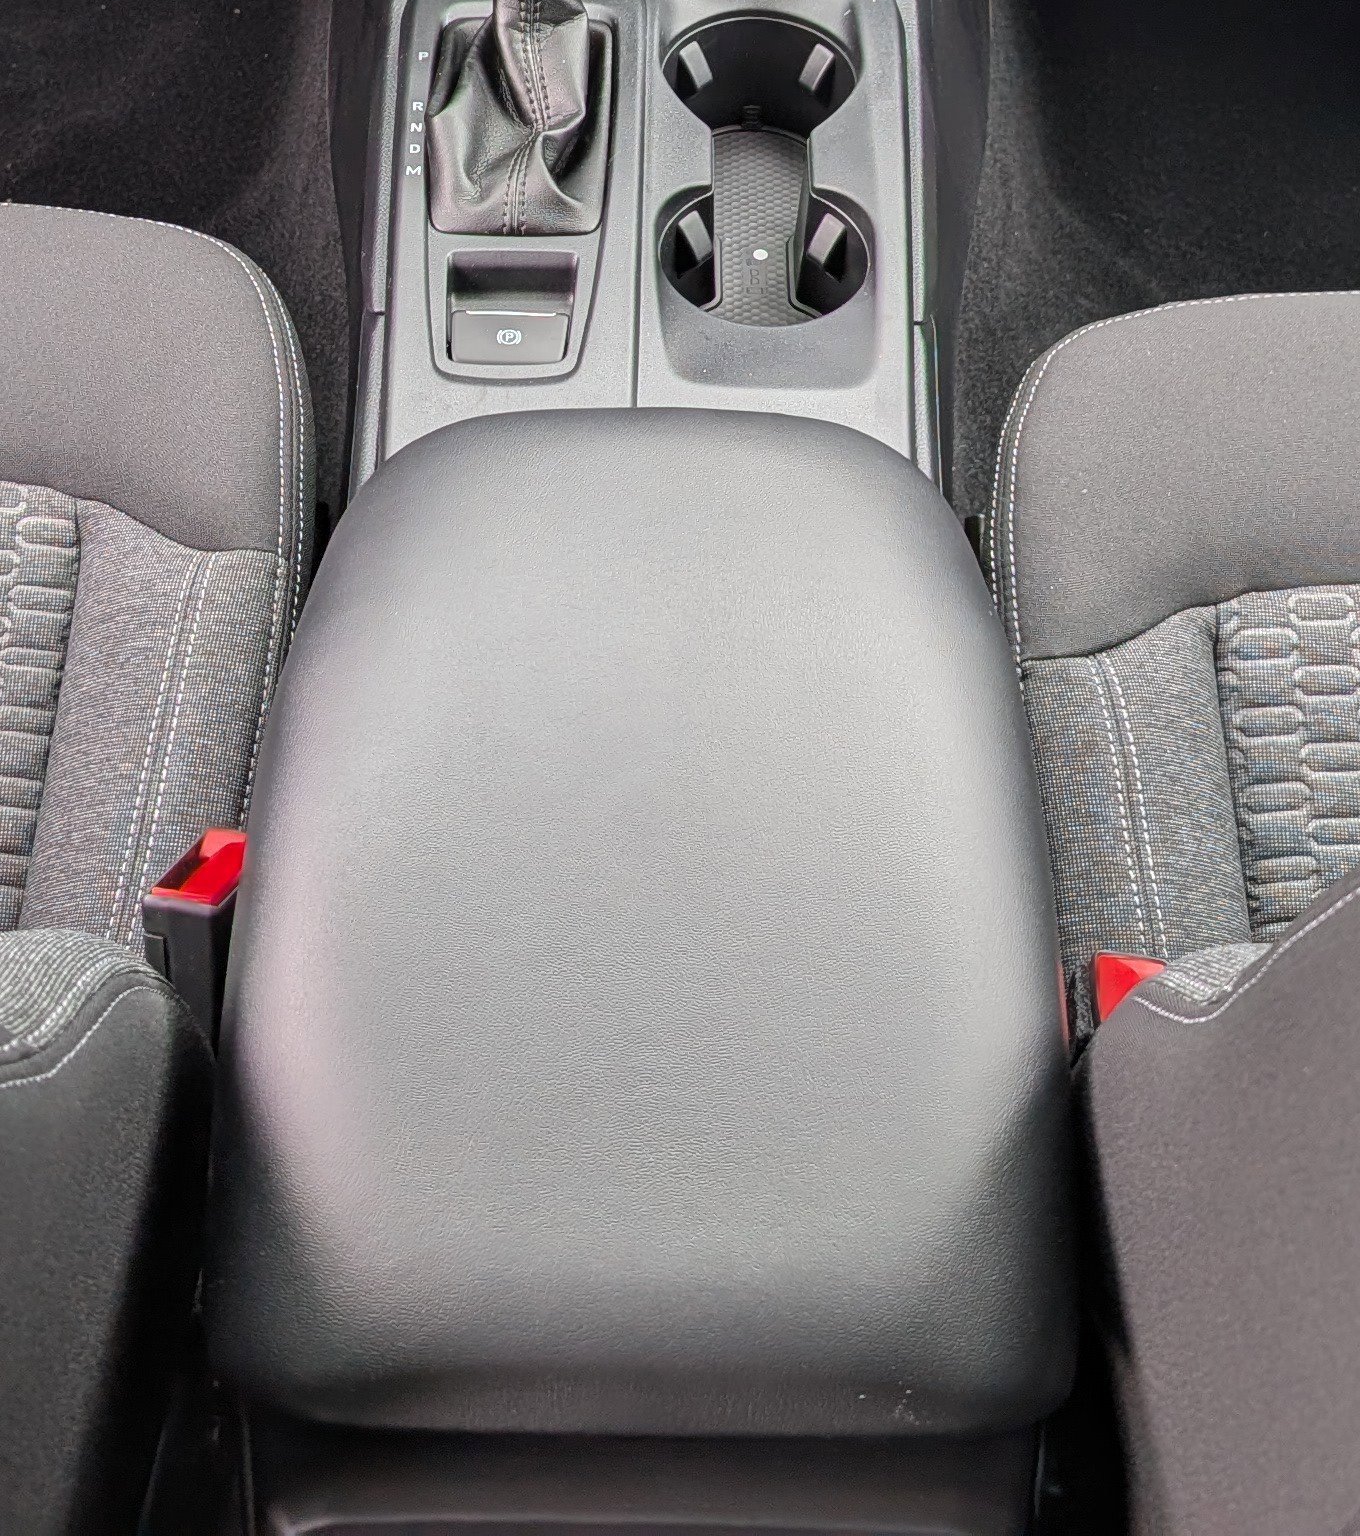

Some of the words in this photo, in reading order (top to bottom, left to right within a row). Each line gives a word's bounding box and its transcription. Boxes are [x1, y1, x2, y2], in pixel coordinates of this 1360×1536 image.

[418, 51, 429, 61] P
[412, 101, 424, 111] R
[410, 122, 423, 133] N
[409, 143, 421, 154] D
[405, 165, 423, 176] M
